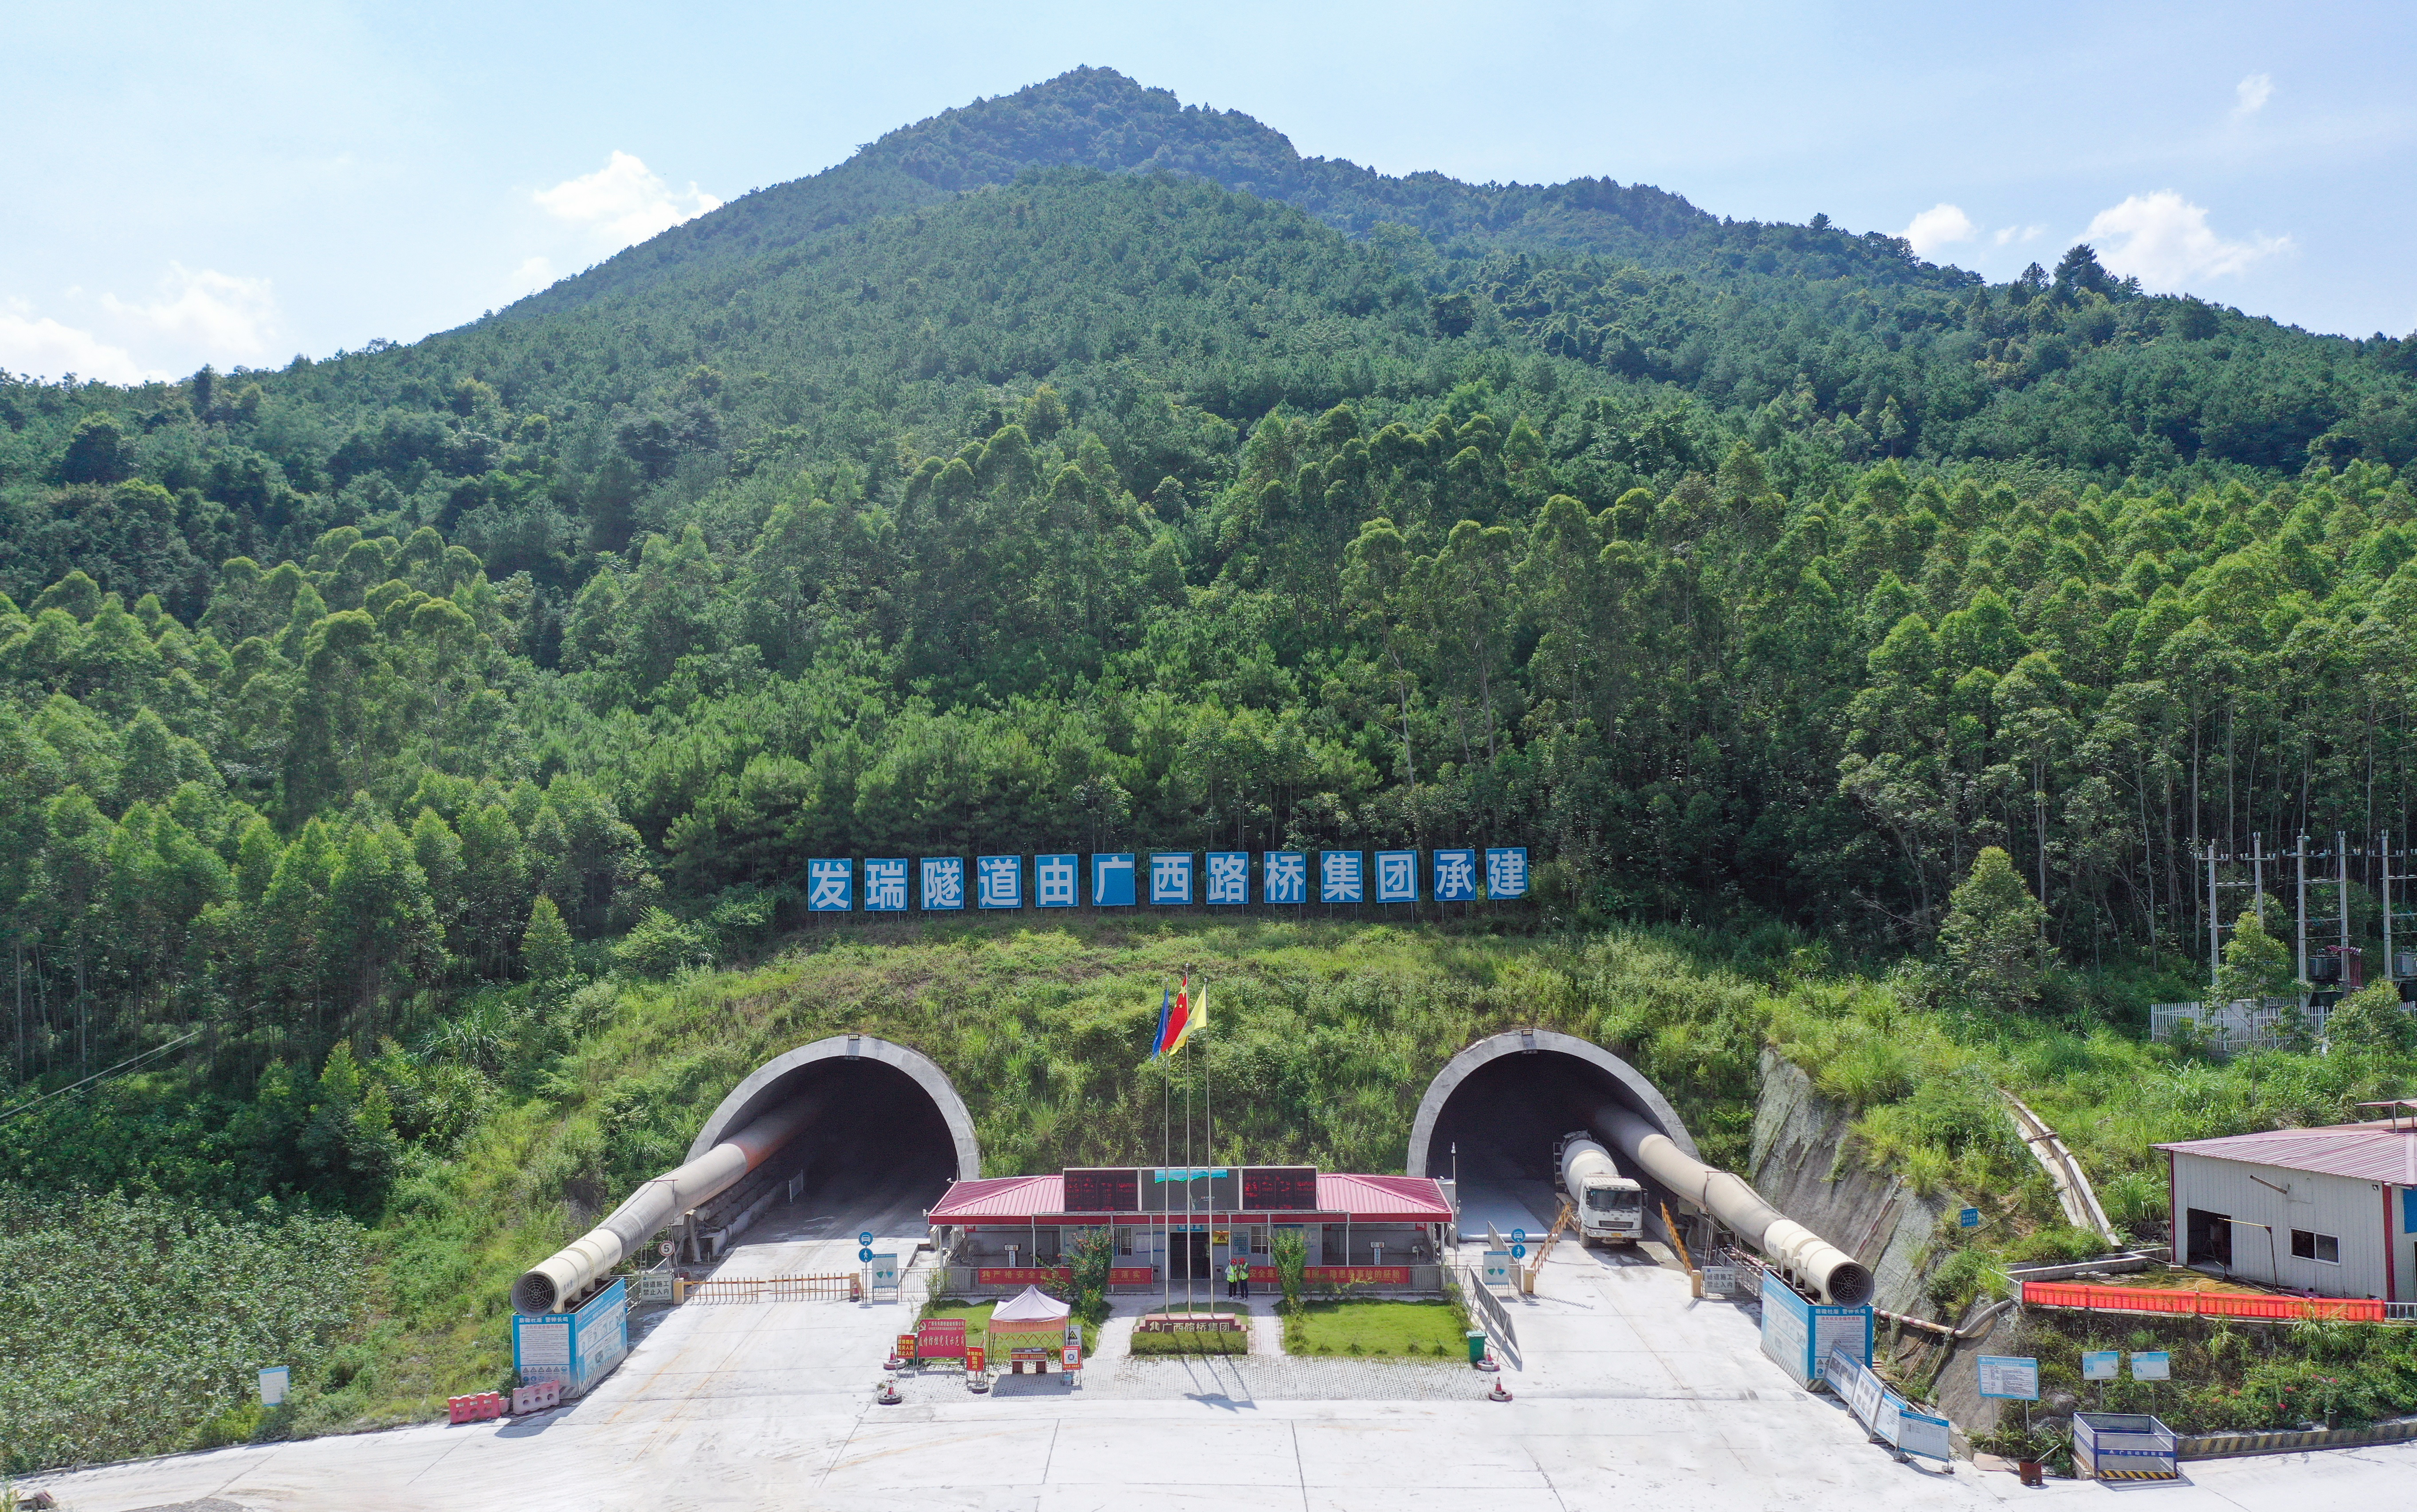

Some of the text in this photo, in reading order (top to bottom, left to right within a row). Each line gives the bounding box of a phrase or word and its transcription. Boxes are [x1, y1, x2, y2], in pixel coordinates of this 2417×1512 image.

[810, 850, 1526, 909] 发瑞隧道由广西路桥集团承建
[1162, 1322, 1230, 1332] 广西路桥集团
